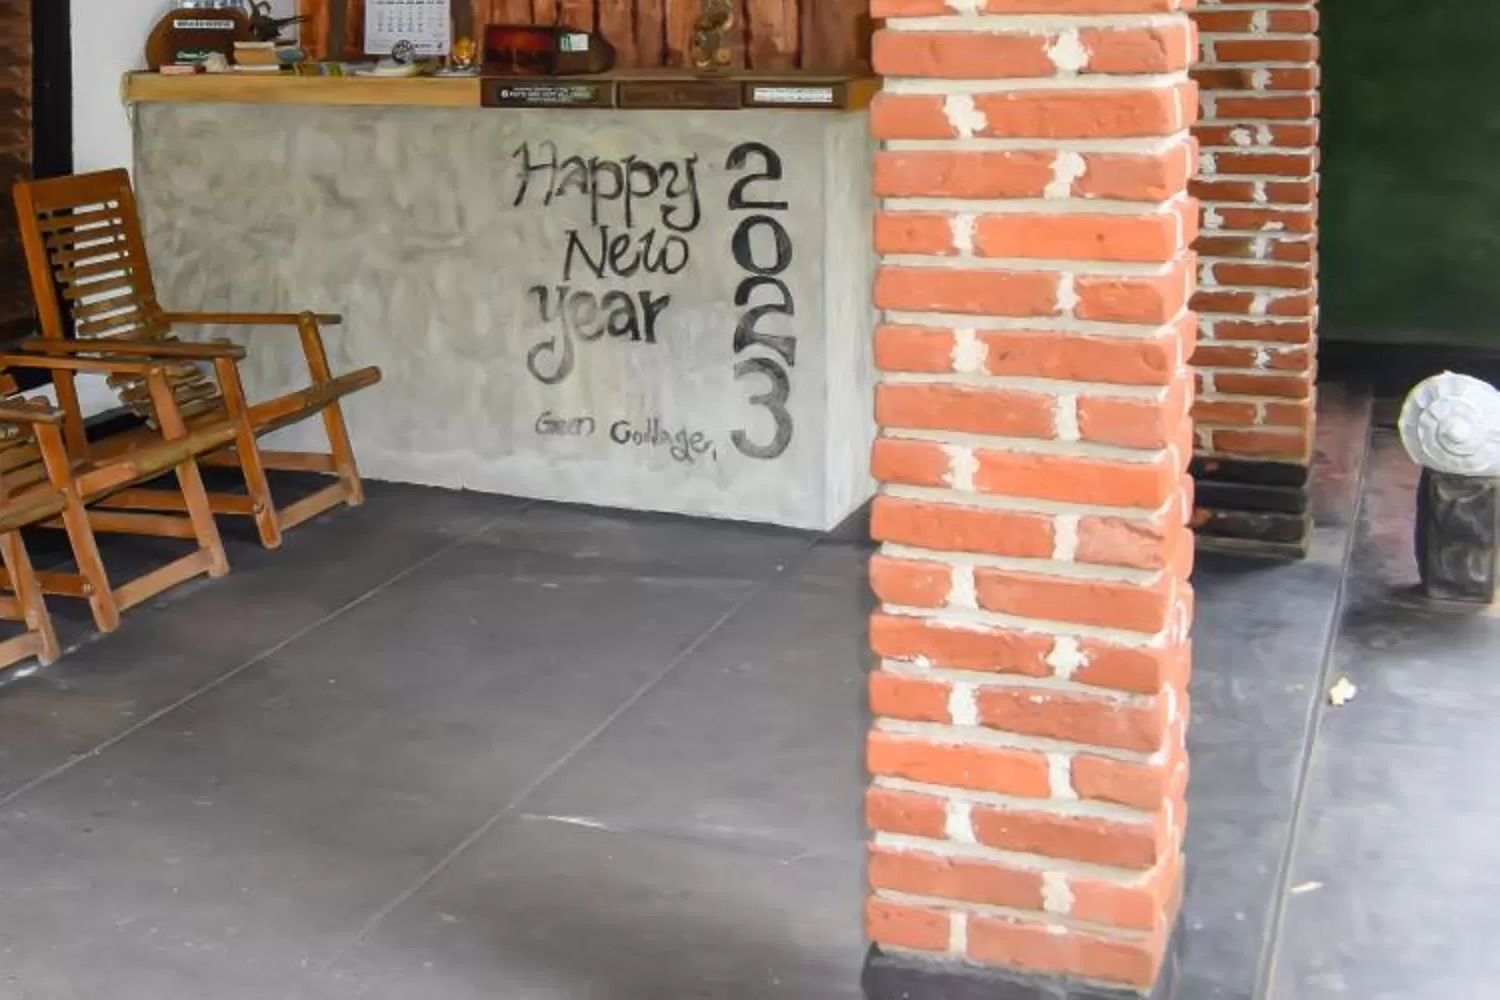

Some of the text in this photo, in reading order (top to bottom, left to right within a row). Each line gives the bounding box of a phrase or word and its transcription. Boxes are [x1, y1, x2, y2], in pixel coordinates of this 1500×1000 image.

[511, 140, 701, 233] Happy
[563, 225, 690, 281] New
[724, 141, 798, 461] 2023
